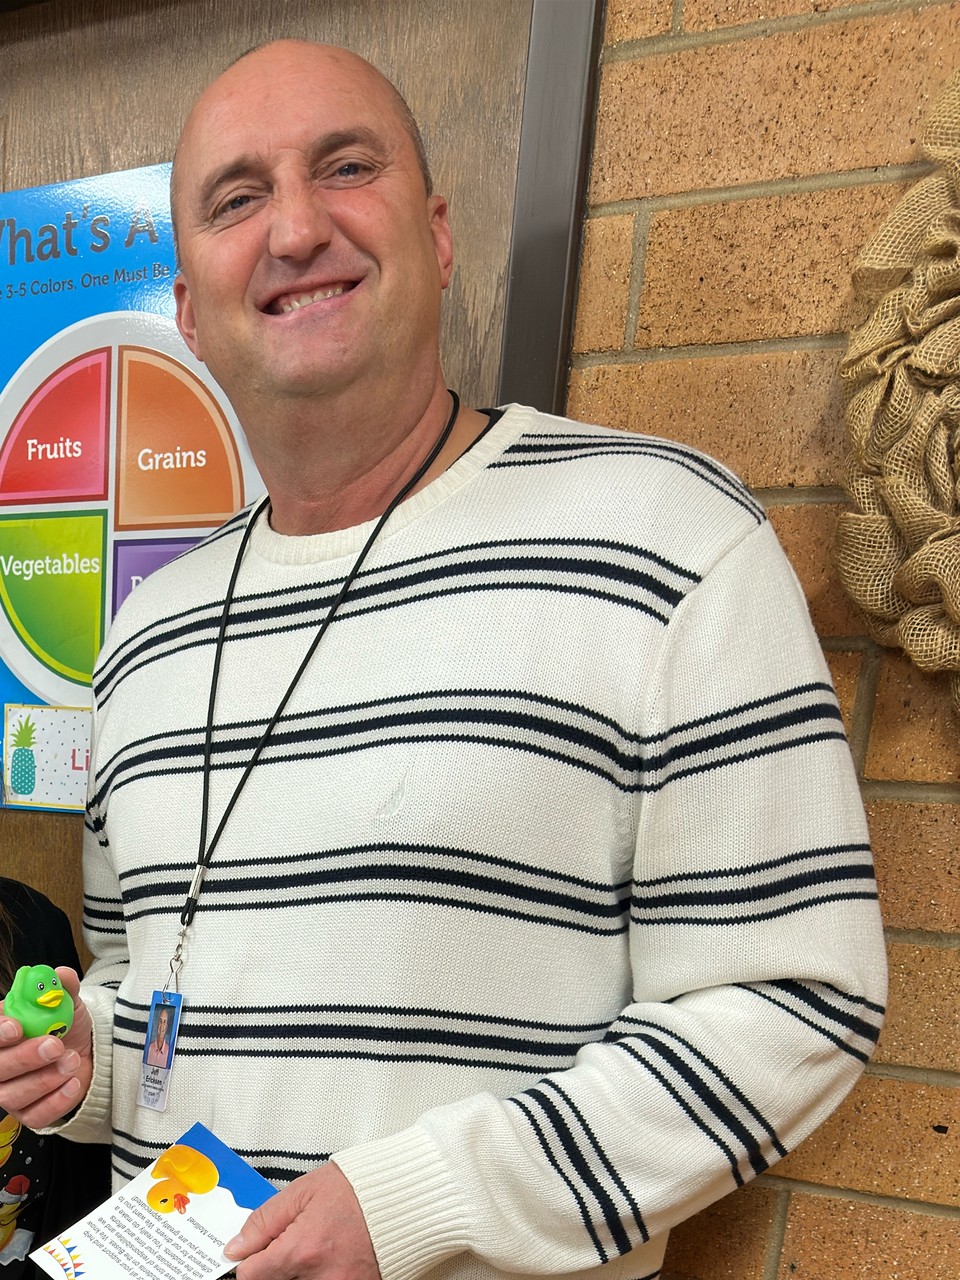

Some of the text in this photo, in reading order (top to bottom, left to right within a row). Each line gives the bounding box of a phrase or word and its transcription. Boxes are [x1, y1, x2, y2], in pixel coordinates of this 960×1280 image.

[124, 204, 159, 248] A
[5, 282, 27, 300] 3-5
[30, 278, 76, 296] Colors.
[80, 272, 110, 289] One
[113, 266, 148, 284] Must
[152, 263, 170, 279] Be
[27, 437, 82, 461] Fruits
[137, 446, 207, 471] Grains
[0, 553, 100, 581] Vegetables
